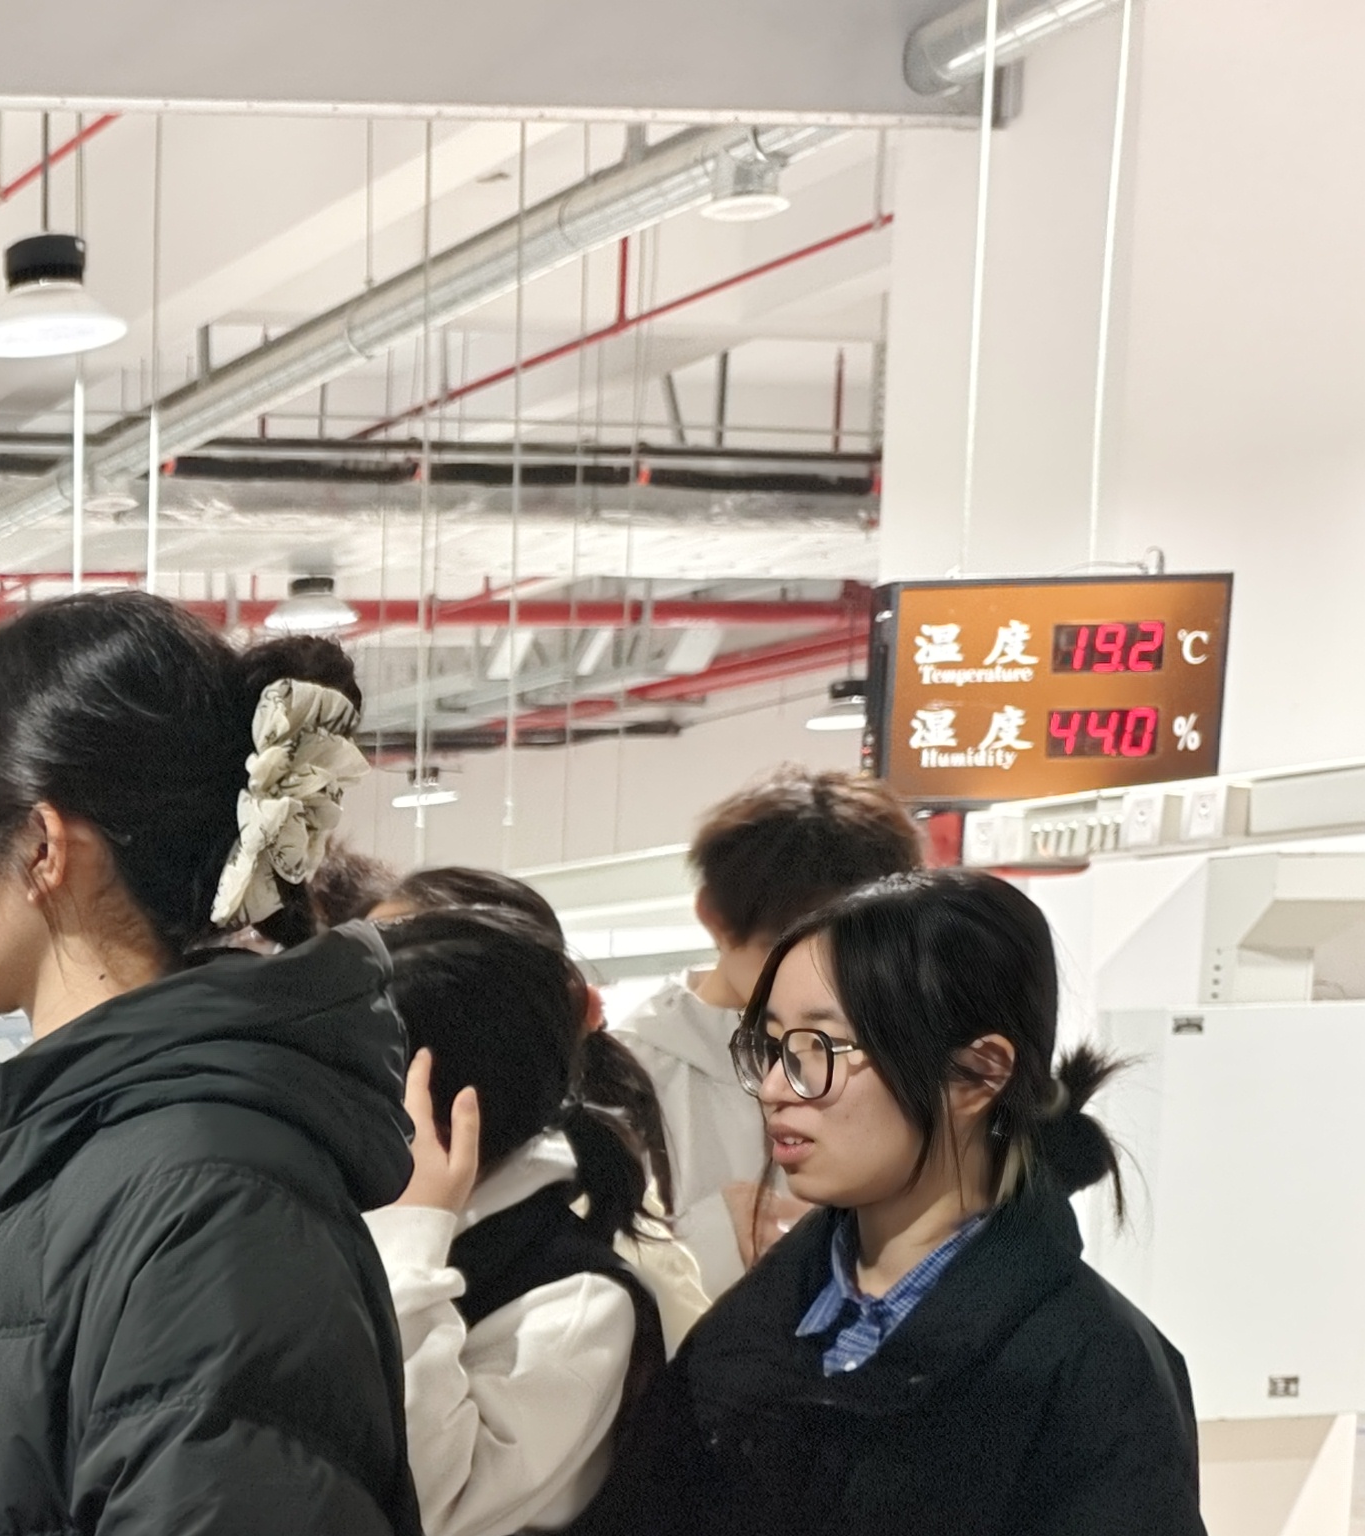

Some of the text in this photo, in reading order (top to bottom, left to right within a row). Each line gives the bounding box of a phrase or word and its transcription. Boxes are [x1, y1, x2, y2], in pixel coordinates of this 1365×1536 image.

[914, 619, 1039, 665] 温度
[1072, 620, 1164, 673] 19.2
[918, 664, 1034, 686] Temperature
[909, 704, 1034, 750] 湿度
[921, 747, 1018, 769] Humidity
